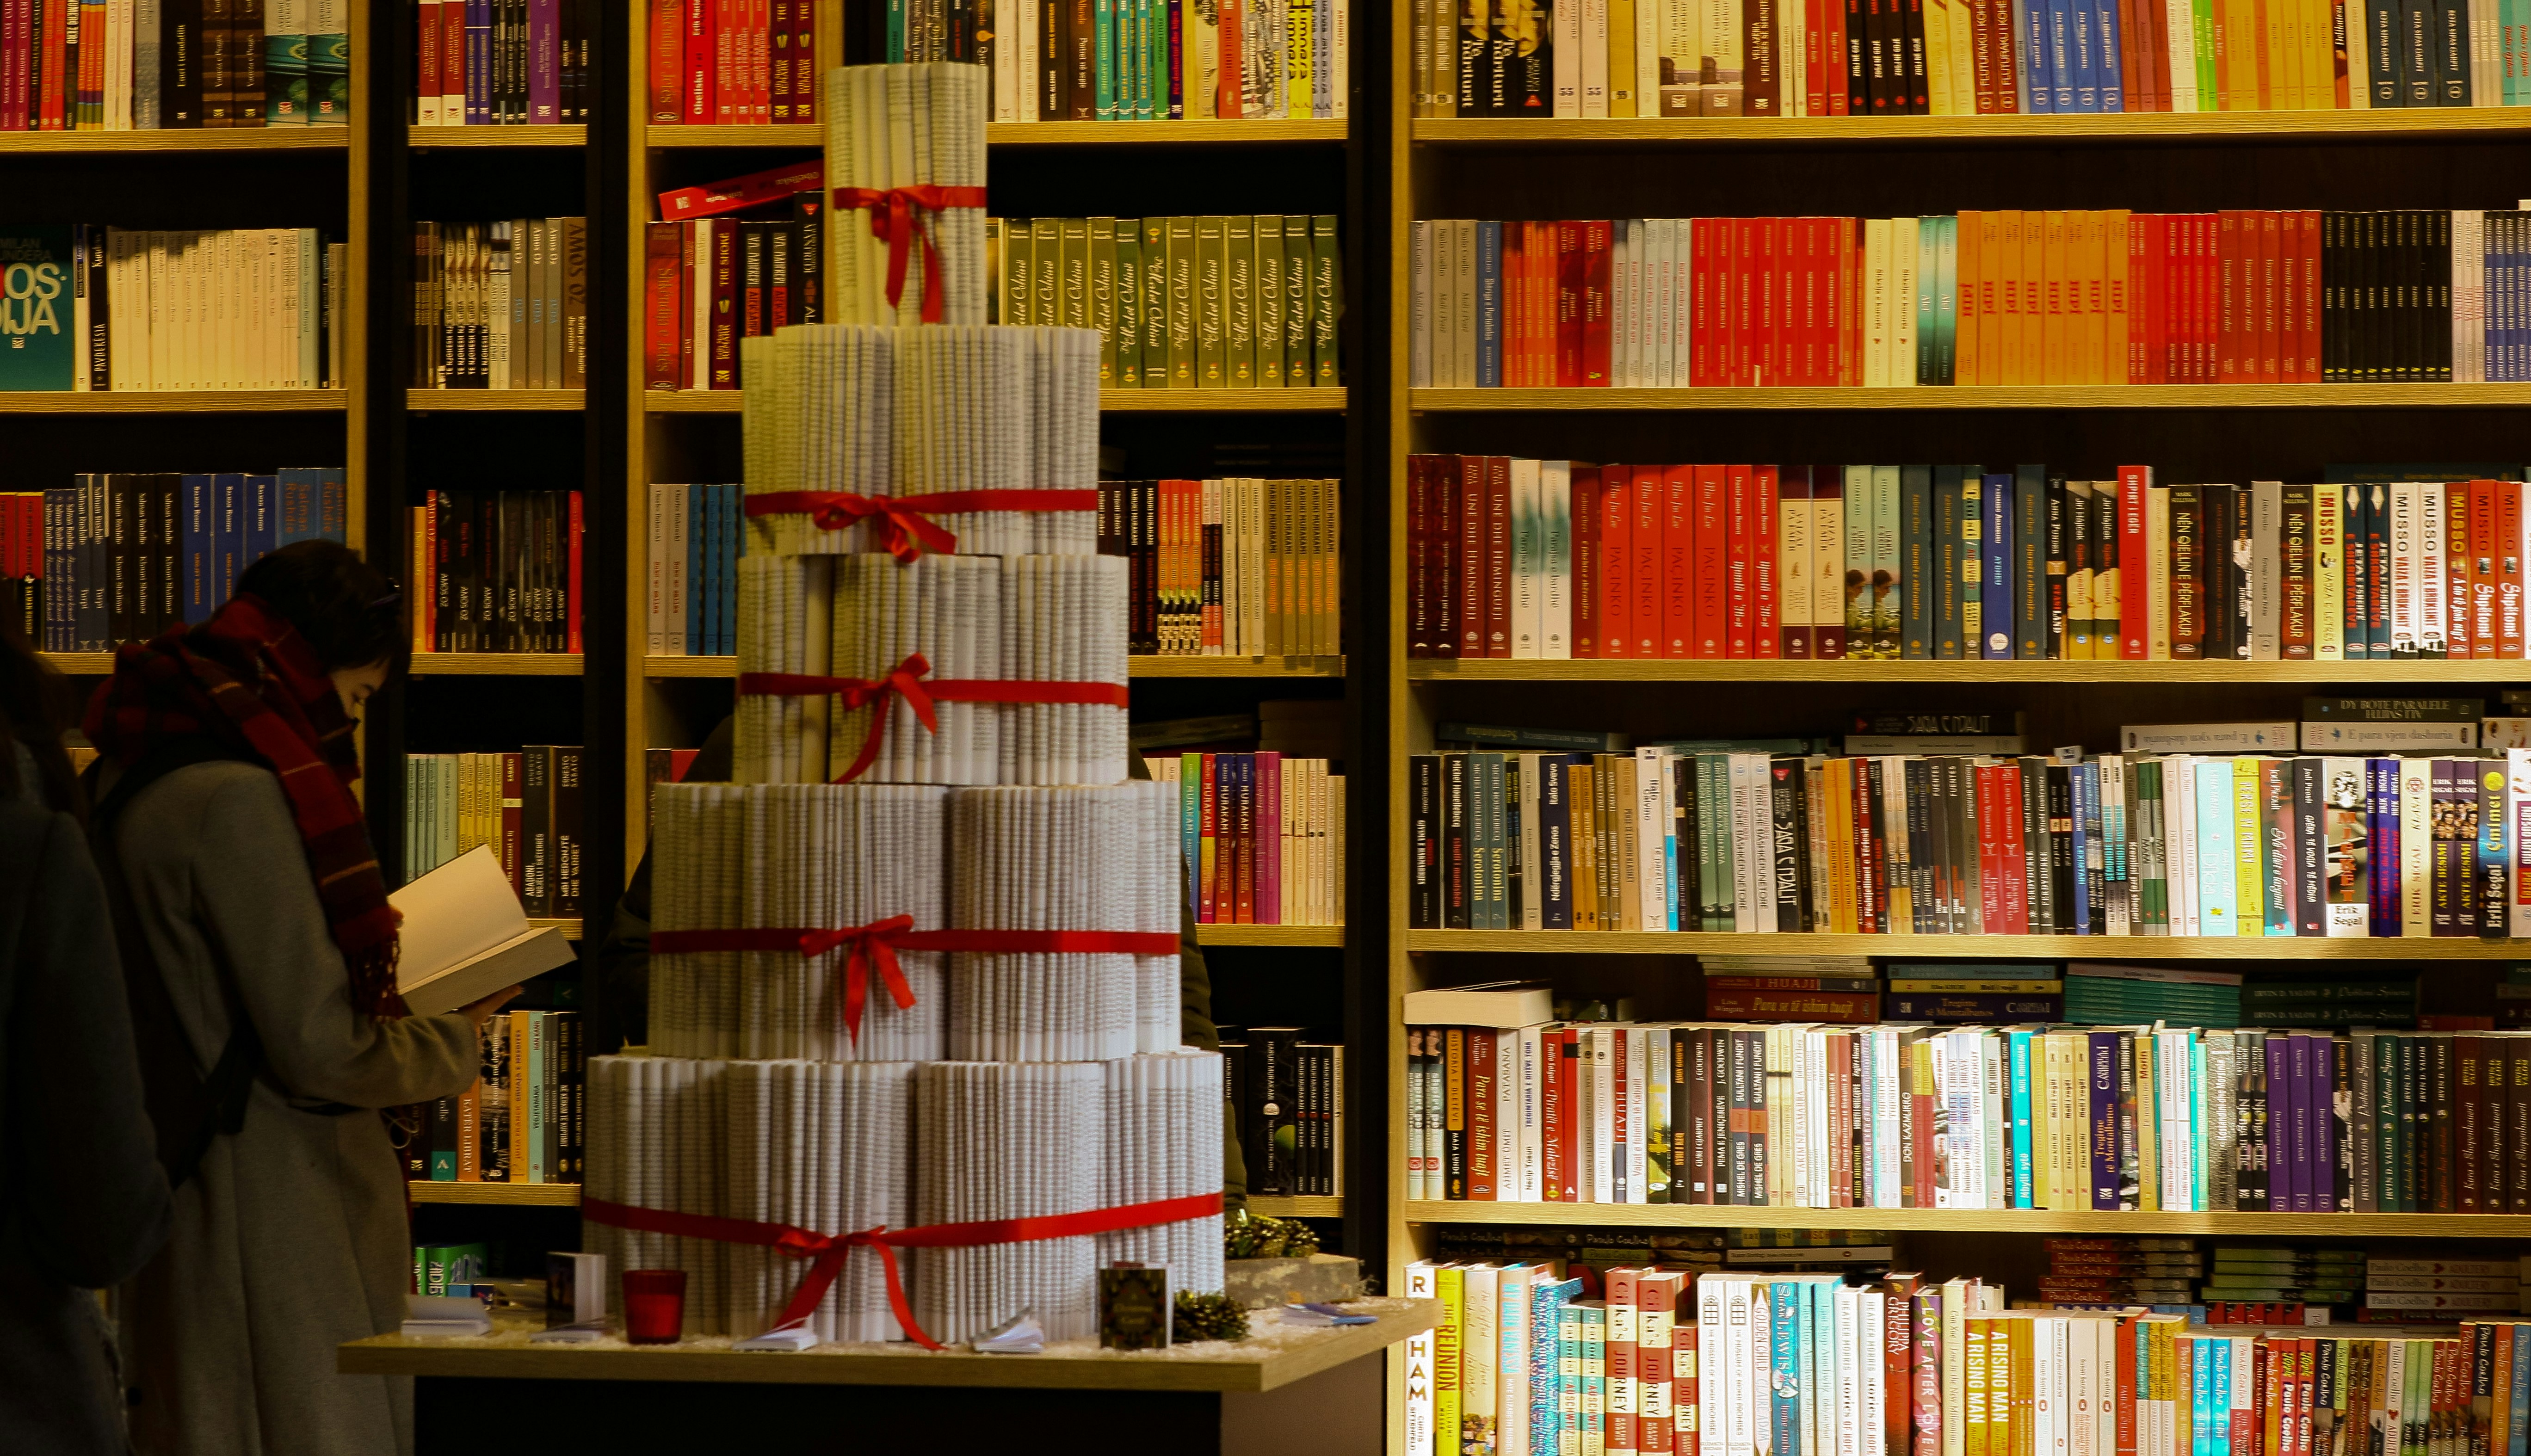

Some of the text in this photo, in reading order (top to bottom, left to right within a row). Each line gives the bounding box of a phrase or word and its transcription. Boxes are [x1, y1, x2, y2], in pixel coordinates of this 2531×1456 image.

[568, 223, 585, 306] AMOS OZ
[2424, 495, 2437, 551] MUSSO
[2451, 496, 2466, 553] MUSSO
[1932, 765, 1940, 796] FUENTES
[1949, 766, 1957, 796] FUENTES
[1220, 785, 1229, 833] MURAKAMI
[1241, 785, 1249, 833] MURAKAMI
[2438, 881, 2447, 908] AKTE
[2461, 881, 2471, 908] AKTE
[2485, 864, 2504, 928] Erik Segal
[1475, 1074, 1490, 1098] Para
[1475, 1101, 1487, 1110] se
[1451, 1133, 1460, 1175] MAJA LUNDE
[1475, 1125, 1491, 1151] ishim
[1754, 1162, 1763, 1172] DE
[2384, 1137, 2394, 1199] IRVIN YALOM
[1408, 1276, 1427, 1401] RHAM
[1501, 1284, 1521, 1374] MY DARK VANESSA
[1754, 1307, 1769, 1371] GOLDEN CHILD
[1776, 1320, 1790, 1370] LEWIS
[1887, 1296, 1899, 1355] GREGORY
[1898, 1302, 1909, 1351] PHILIPPA
[1437, 1325, 1457, 1391] REUNION
[1921, 1307, 1934, 1396] LOVE AFTER
[1968, 1345, 1986, 1423] RISING MAN
[1991, 1332, 2009, 1422] A RISING MAN
[1680, 1385, 1692, 1430] JOURNEY
[1780, 1405, 1790, 1427] home
[2299, 1382, 2312, 1452] Paulo Coelho
[1867, 1434, 1877, 1455] HOPE
